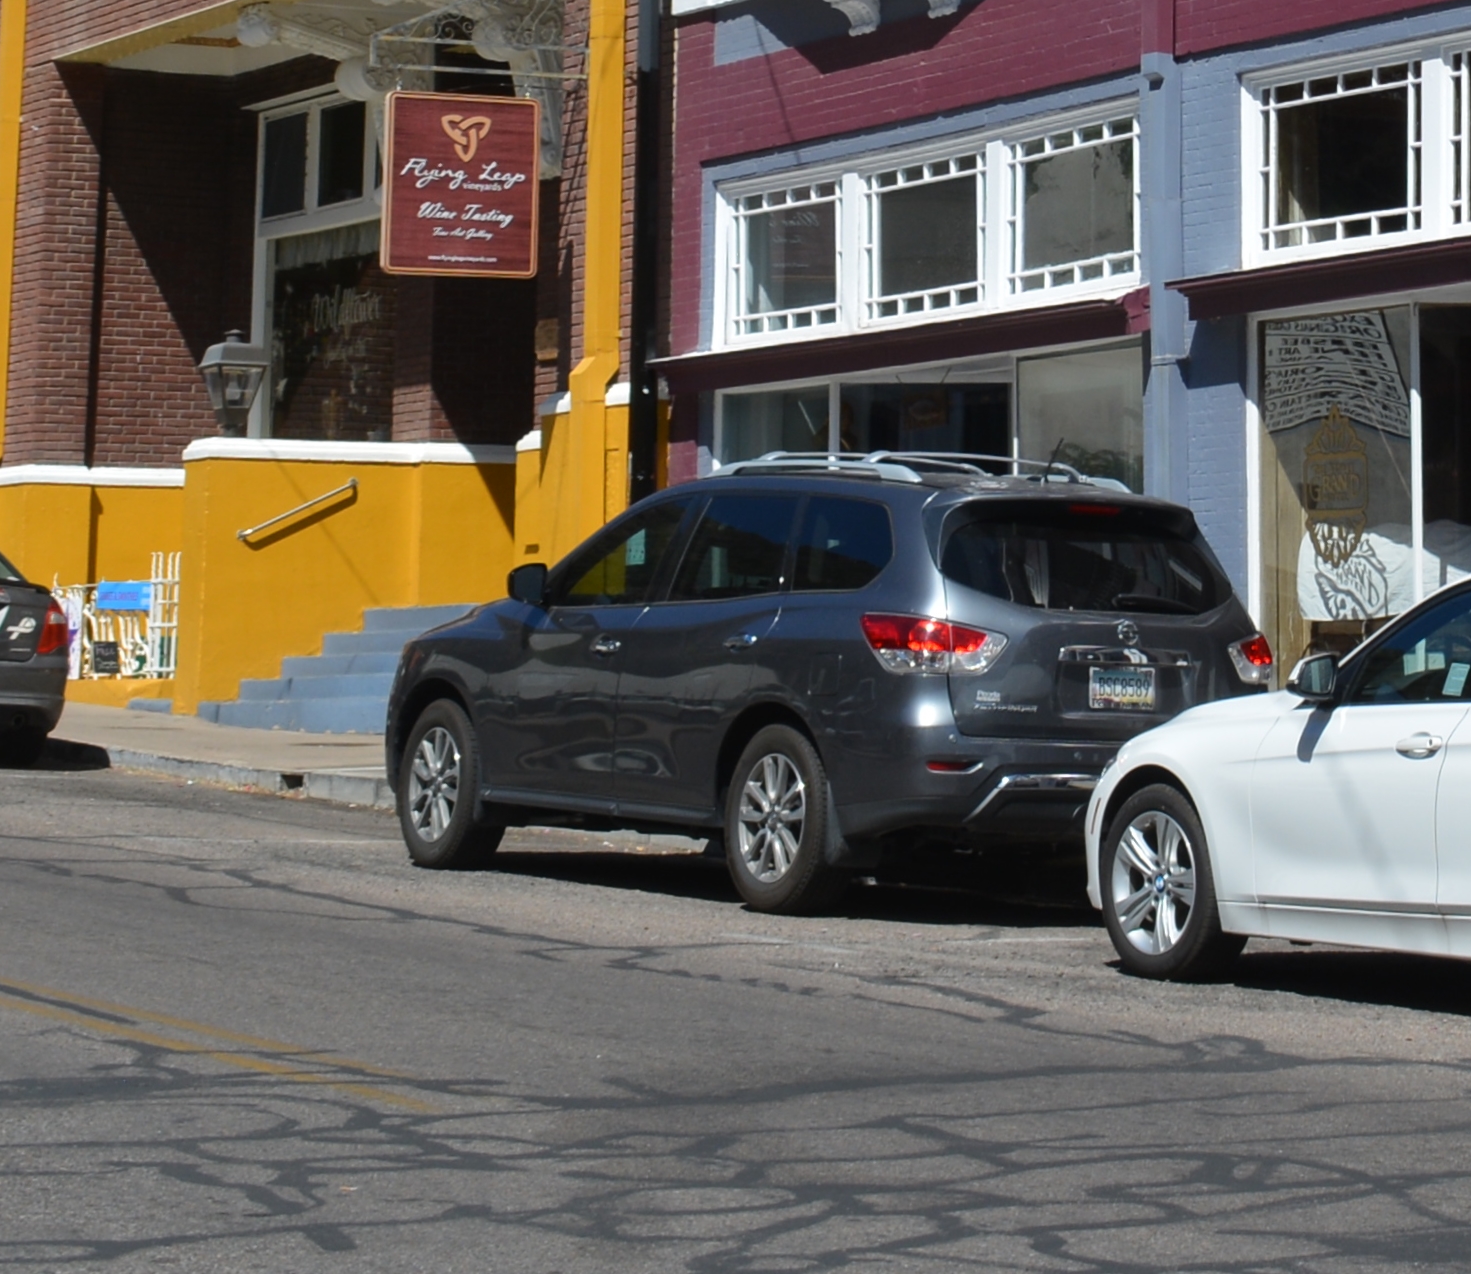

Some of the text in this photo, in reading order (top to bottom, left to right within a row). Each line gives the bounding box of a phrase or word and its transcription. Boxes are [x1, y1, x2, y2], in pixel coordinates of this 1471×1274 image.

[400, 157, 526, 190] Flying Leap
[463, 181, 503, 192] vineyards
[417, 201, 515, 229] Wine Tasting
